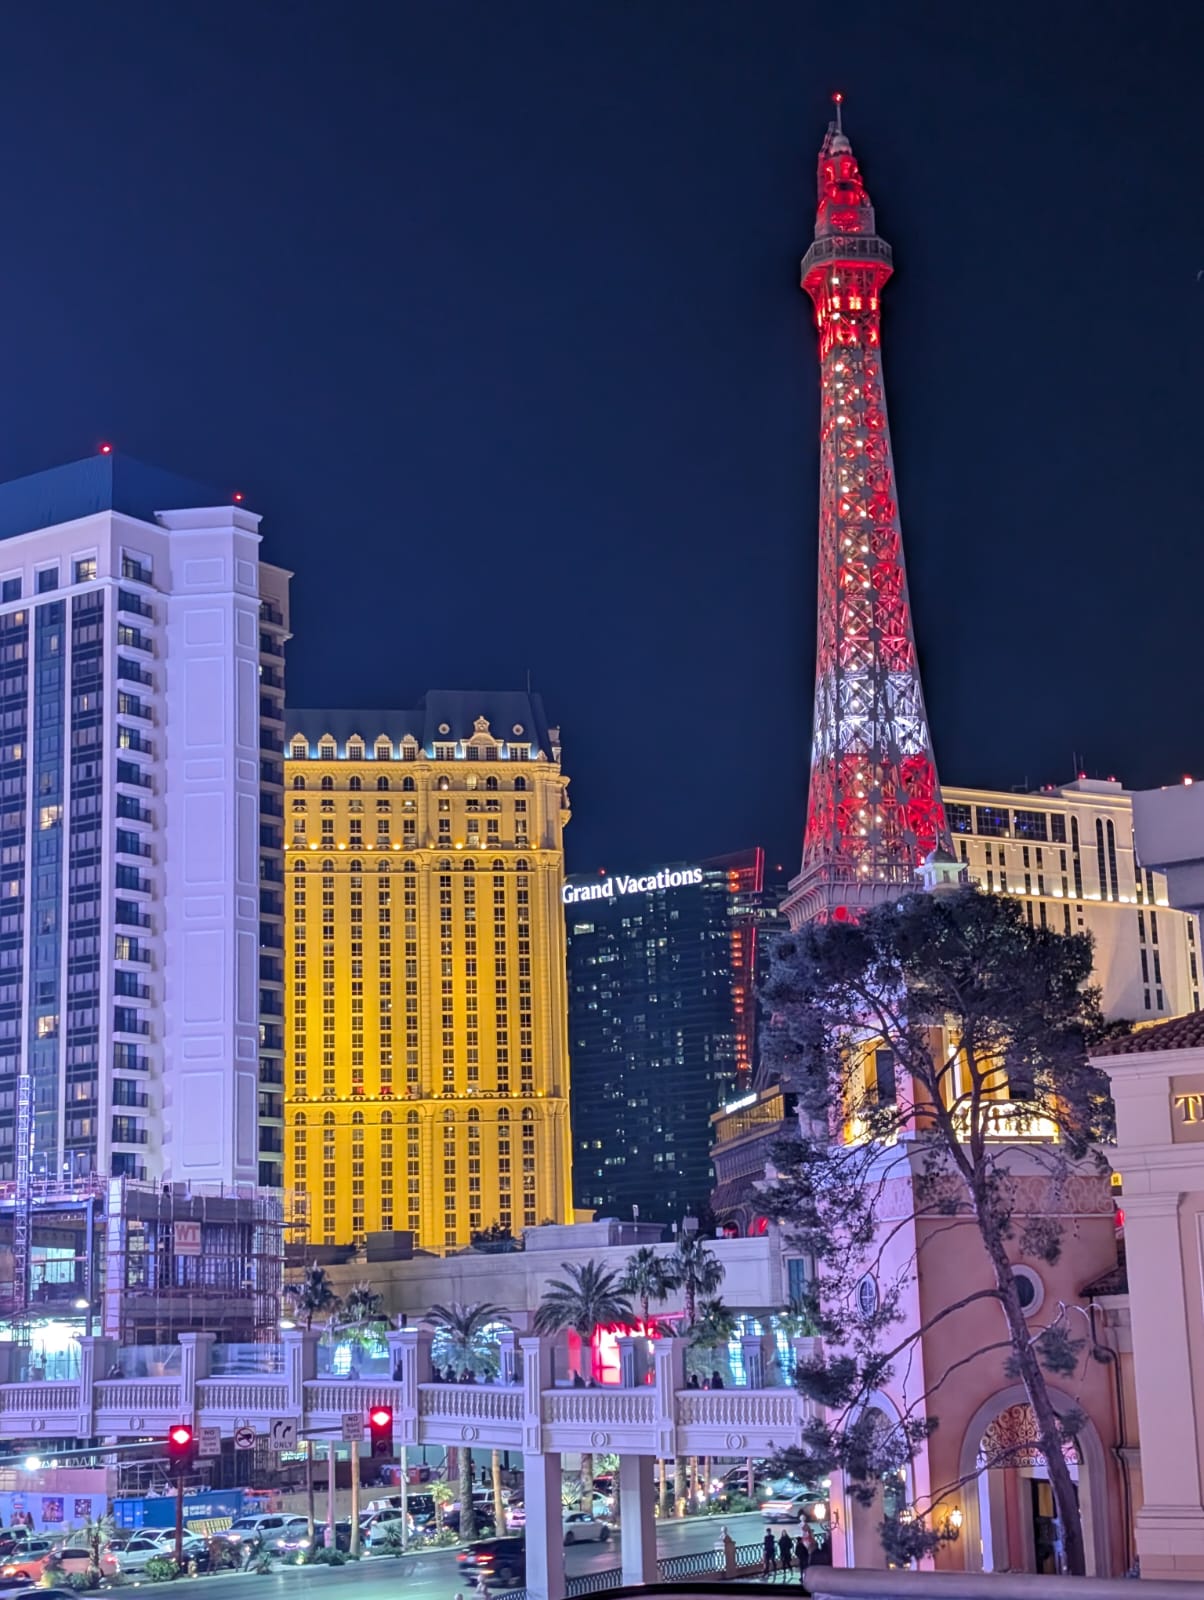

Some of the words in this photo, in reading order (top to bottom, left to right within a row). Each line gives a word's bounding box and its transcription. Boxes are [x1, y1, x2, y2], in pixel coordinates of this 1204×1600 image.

[562, 877, 613, 904] Grand
[616, 868, 702, 895] Vacations
[176, 1224, 200, 1241] WT
[273, 1441, 293, 1449] ONLY
